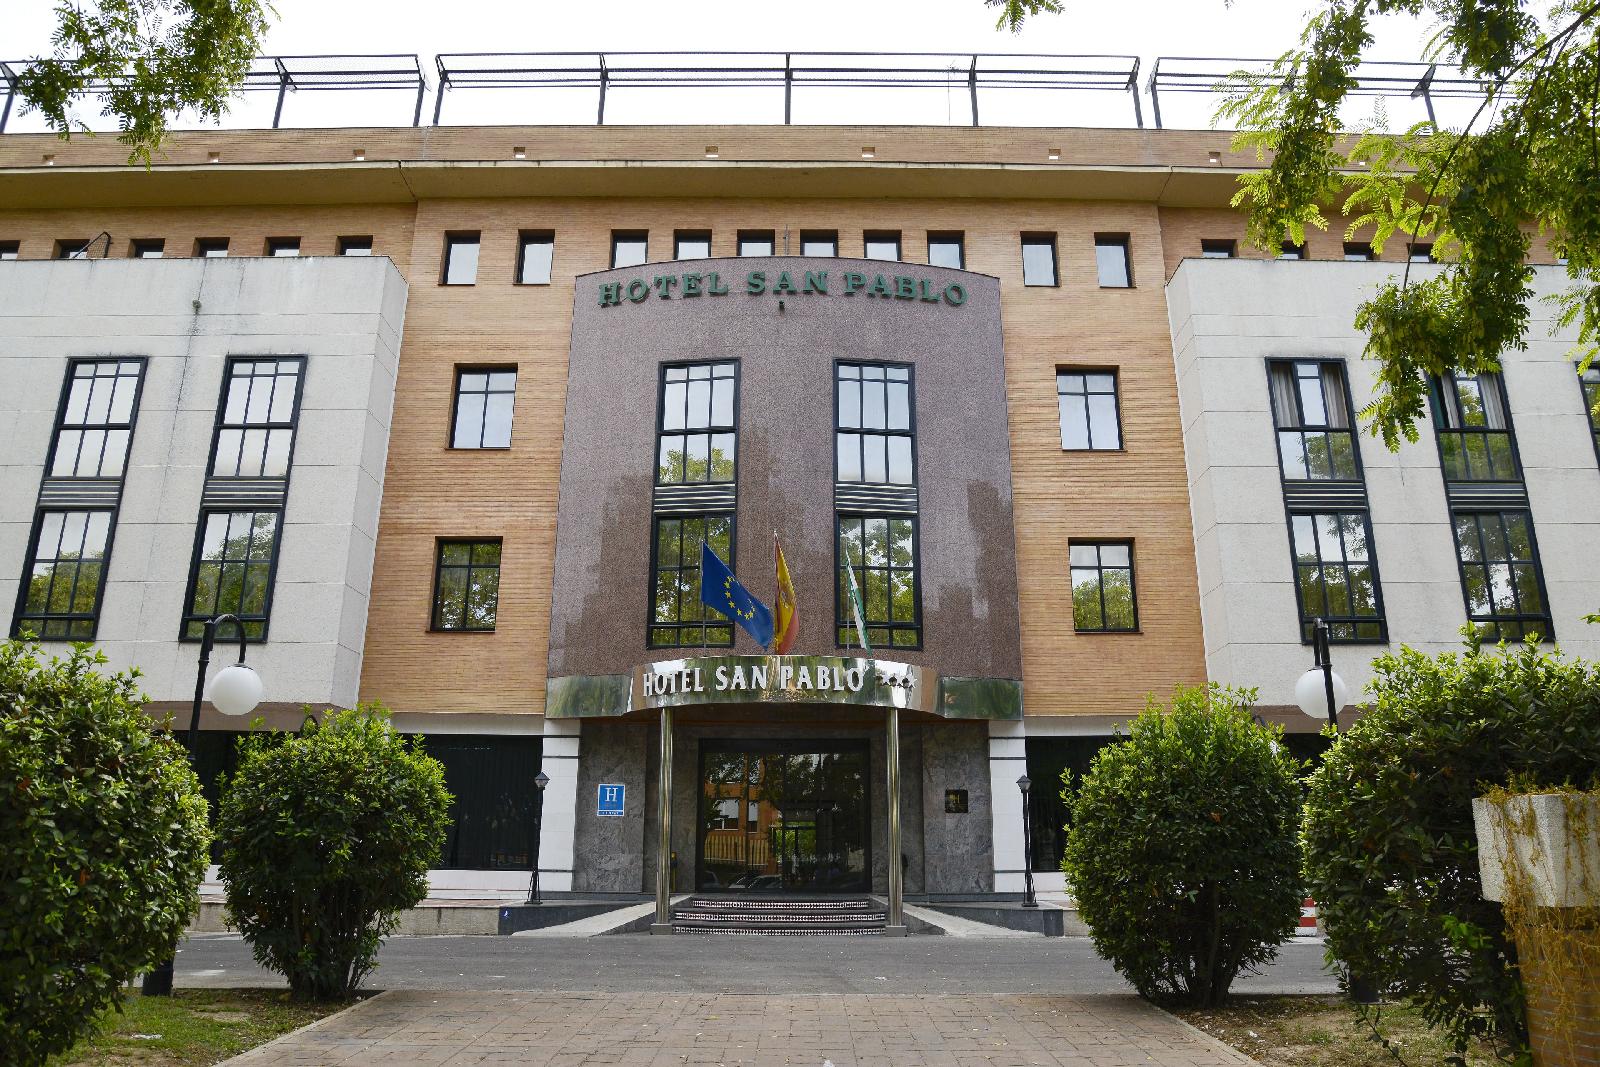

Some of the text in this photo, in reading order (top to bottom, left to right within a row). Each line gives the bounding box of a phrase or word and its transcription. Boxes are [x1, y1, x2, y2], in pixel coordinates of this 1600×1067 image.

[598, 270, 968, 307] HOTEL SAN PABLO
[643, 665, 865, 697] HOTEL SAN PABLO
[604, 787, 619, 802] H
